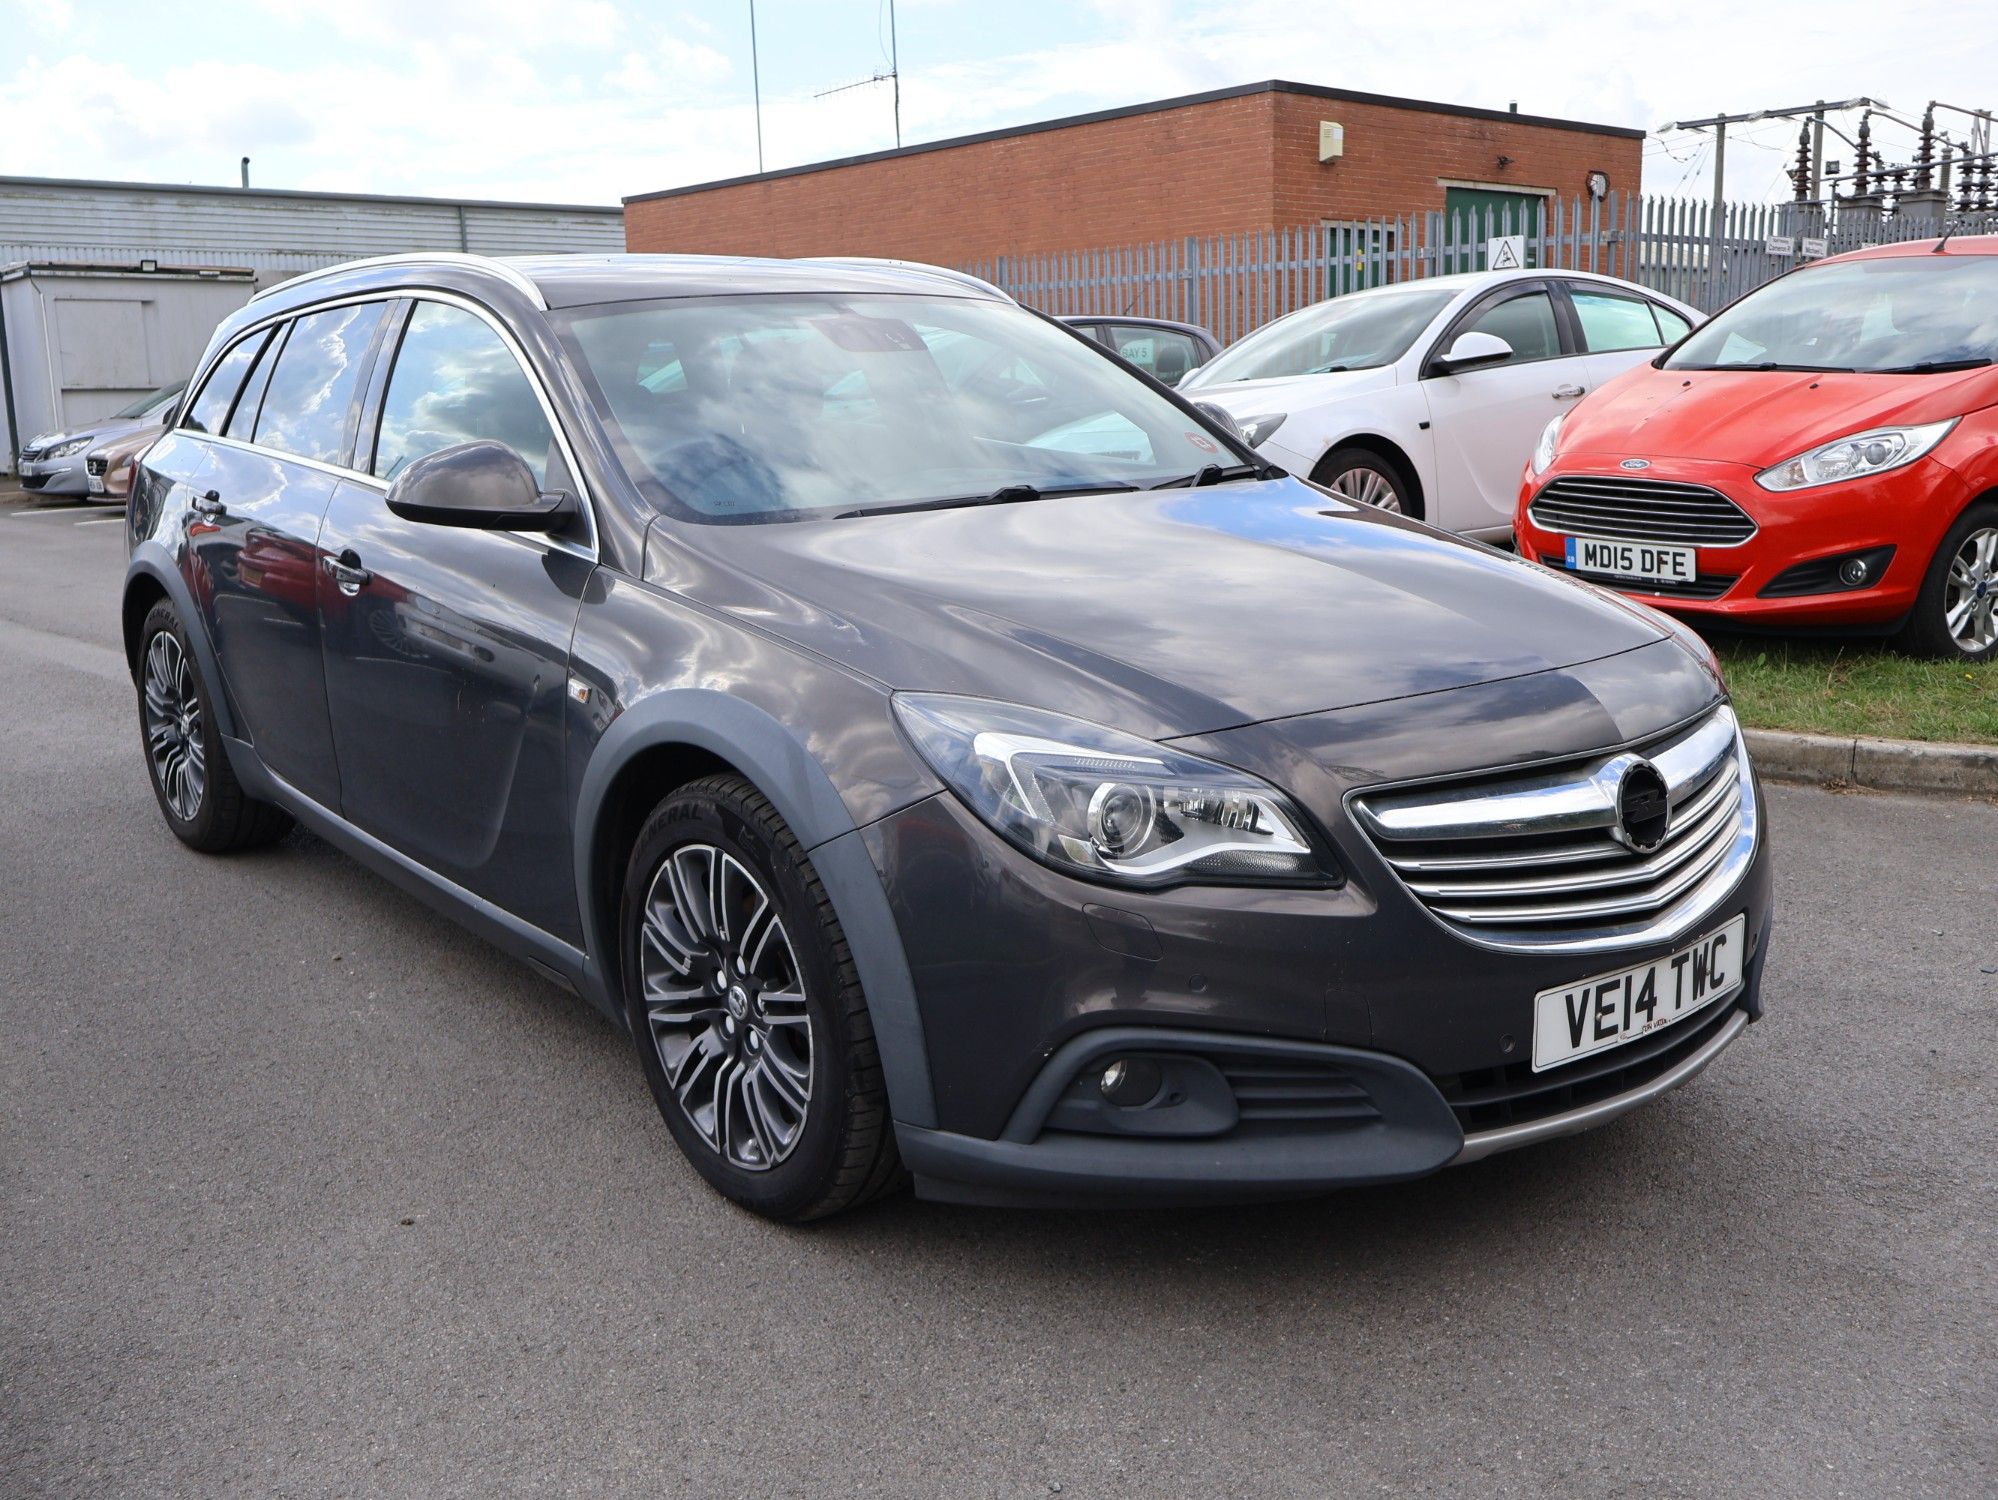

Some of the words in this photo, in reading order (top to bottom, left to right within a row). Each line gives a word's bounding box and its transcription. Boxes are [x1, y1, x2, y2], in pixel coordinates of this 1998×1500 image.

[1584, 543, 1633, 571] MD15
[1641, 549, 1687, 577] DFE
[1565, 967, 1657, 1049] VE14
[1671, 933, 1727, 1010] TWC
